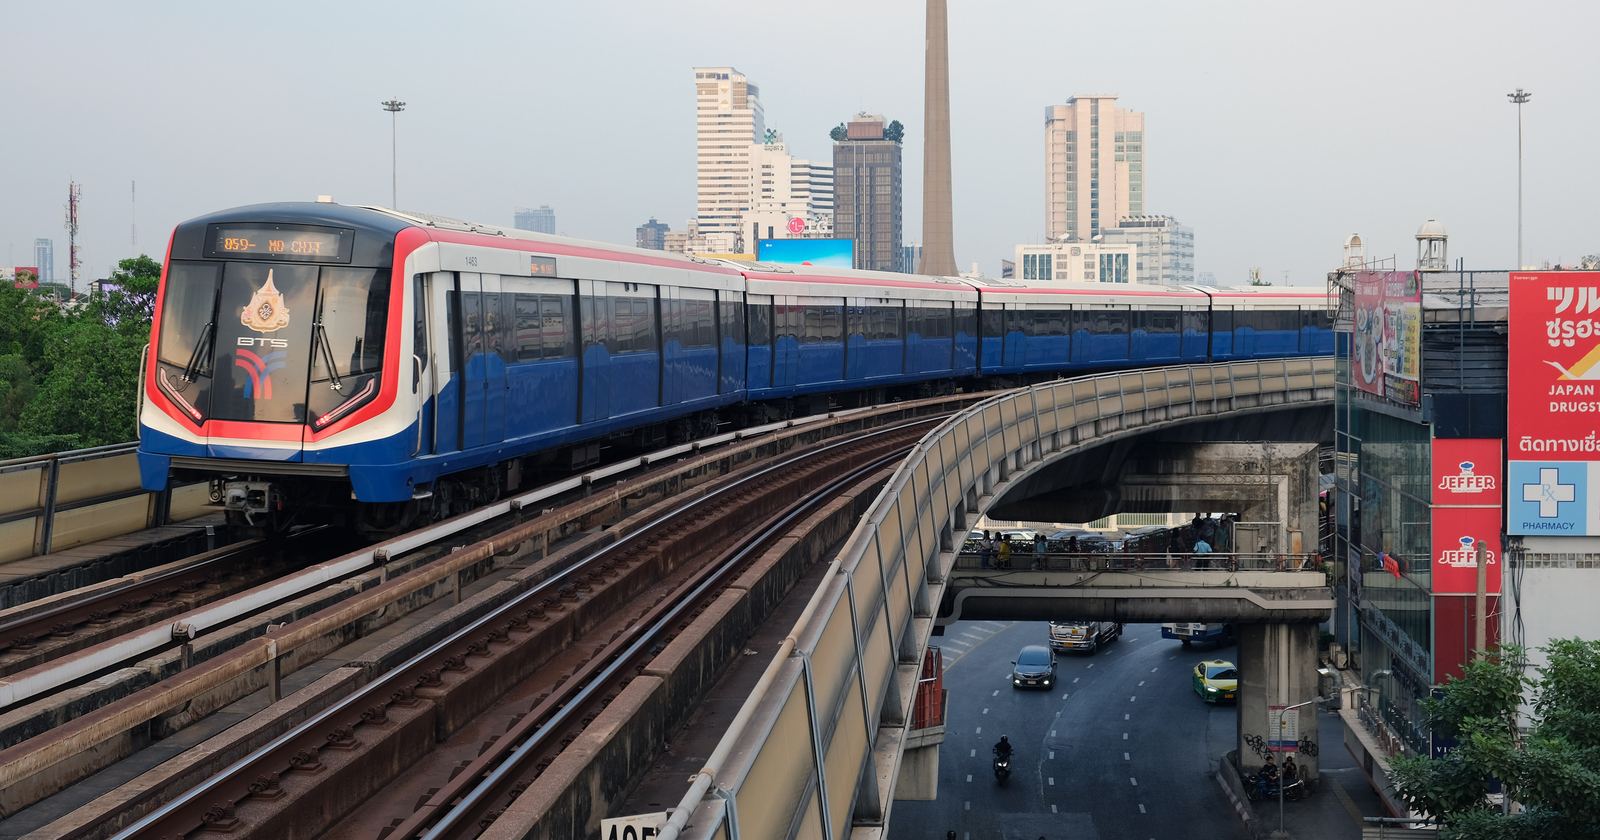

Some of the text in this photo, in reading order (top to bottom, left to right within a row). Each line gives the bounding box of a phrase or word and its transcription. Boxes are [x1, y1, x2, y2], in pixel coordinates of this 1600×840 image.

[237, 337, 288, 348] BTS
[1548, 385, 1594, 396] JAPAN
[1439, 476, 1495, 489] JEFFER
[1522, 522, 1575, 530] PHARMACY
